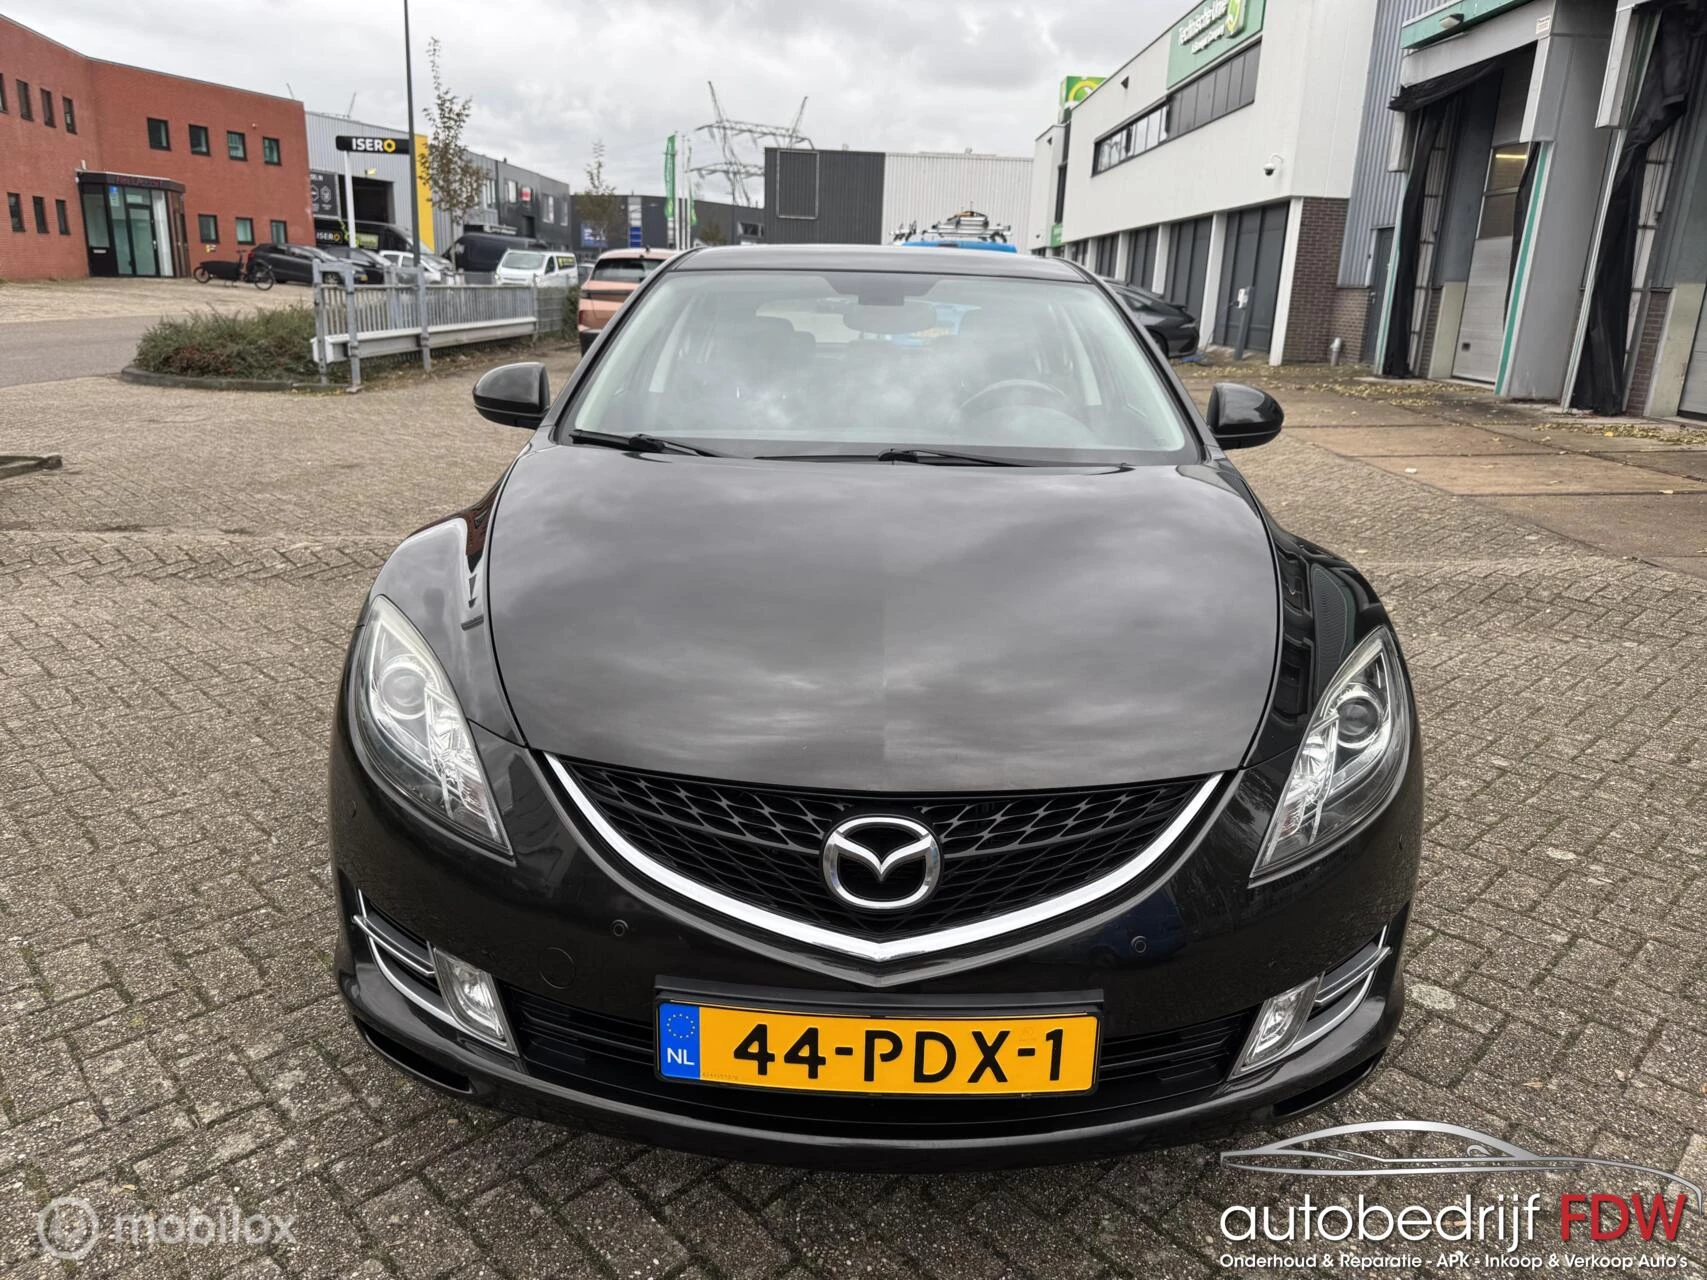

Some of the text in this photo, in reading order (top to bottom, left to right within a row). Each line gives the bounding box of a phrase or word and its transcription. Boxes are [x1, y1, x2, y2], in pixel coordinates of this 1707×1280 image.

[352, 138, 396, 152] ISERO
[666, 1047, 695, 1066] NL
[733, 1023, 1064, 1083] 44-PDX-1
